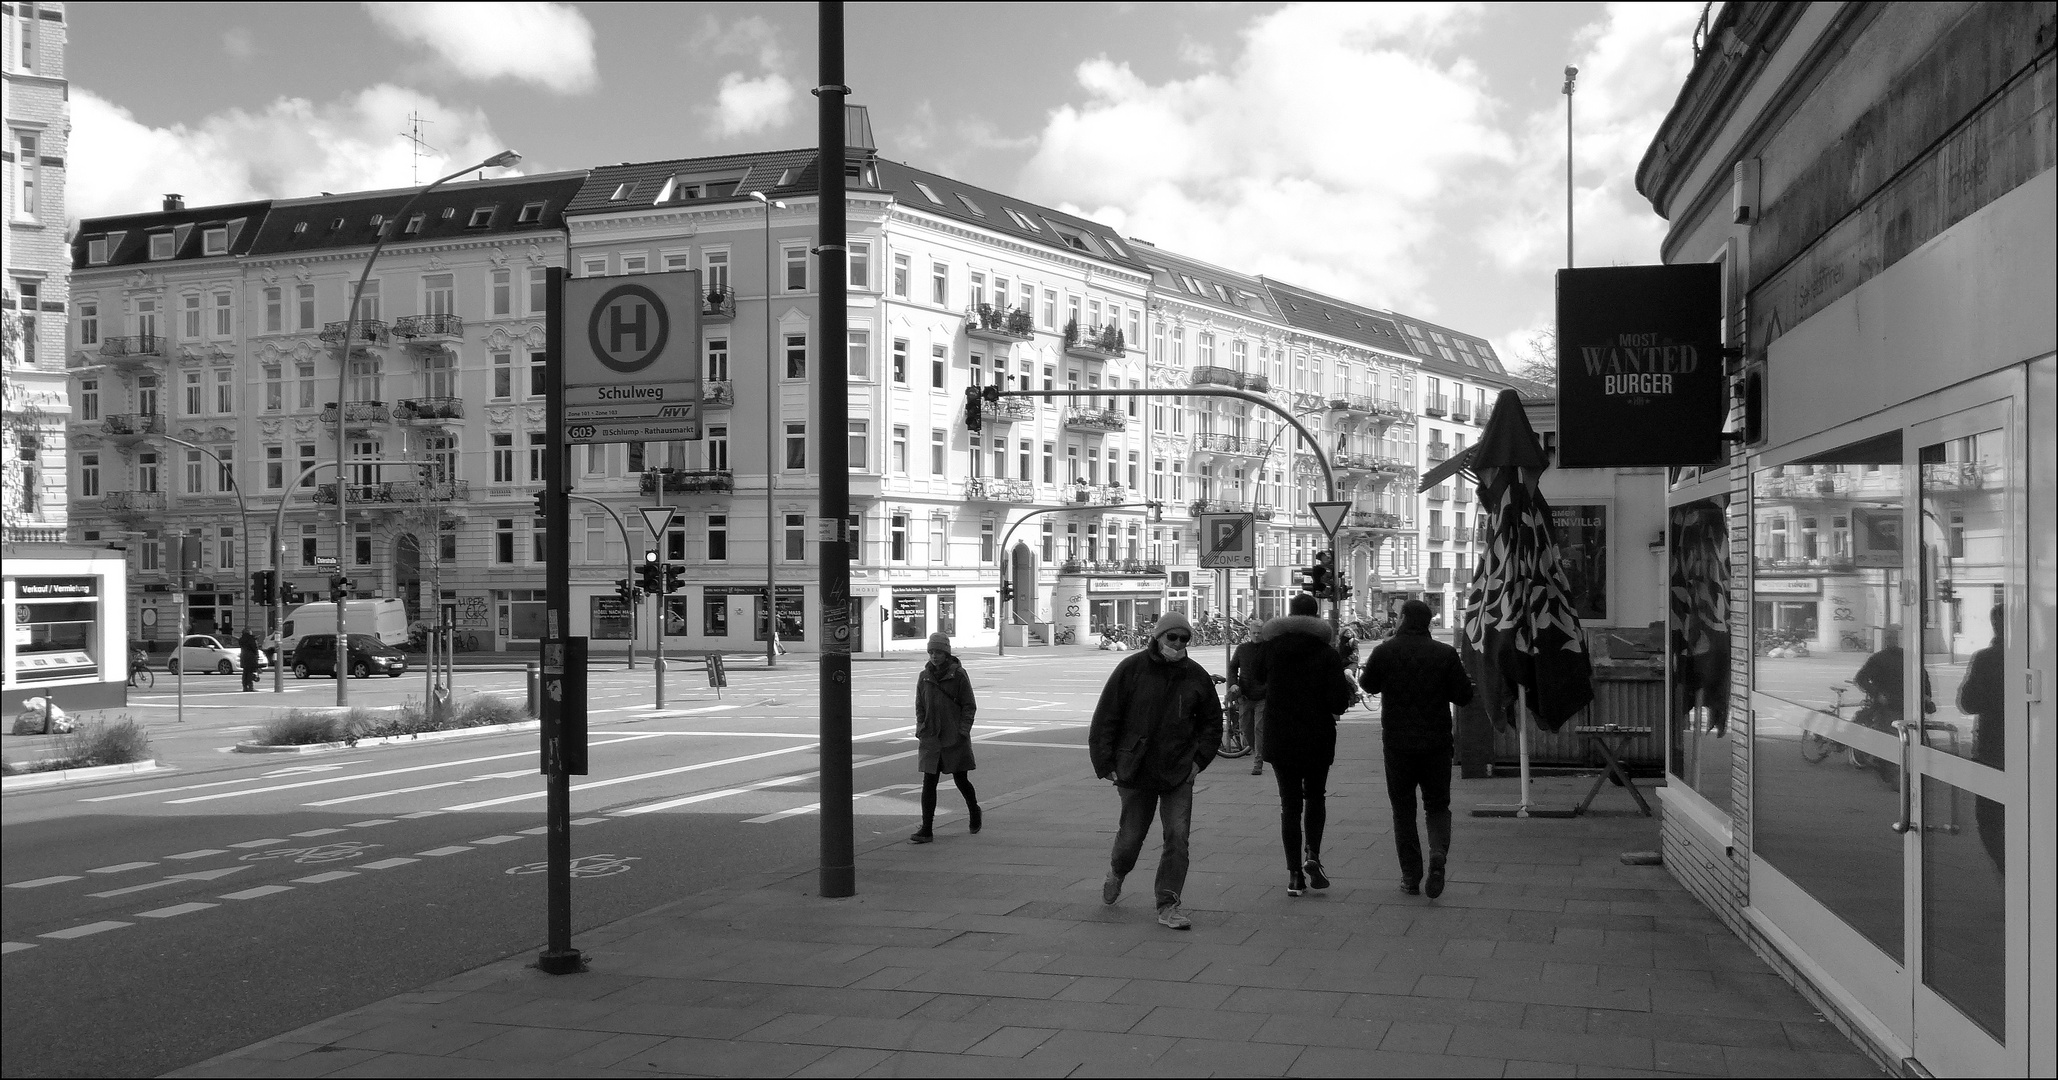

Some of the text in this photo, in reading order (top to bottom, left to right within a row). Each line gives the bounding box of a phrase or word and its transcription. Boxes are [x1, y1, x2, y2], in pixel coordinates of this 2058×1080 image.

[610, 304, 647, 352] H
[1619, 332, 1658, 347] MOST
[1581, 345, 1698, 376] WANTED
[1605, 373, 1673, 395] BURGER
[598, 385, 664, 400] Schulweg
[663, 407, 691, 417] HVV
[572, 426, 594, 438] 603
[609, 428, 640, 437] Schlump
[644, 426, 694, 435] Rathausmarkt
[1213, 555, 1240, 565] ZONE
[22, 584, 48, 593] Verkauf
[53, 584, 90, 594] Vermietung
